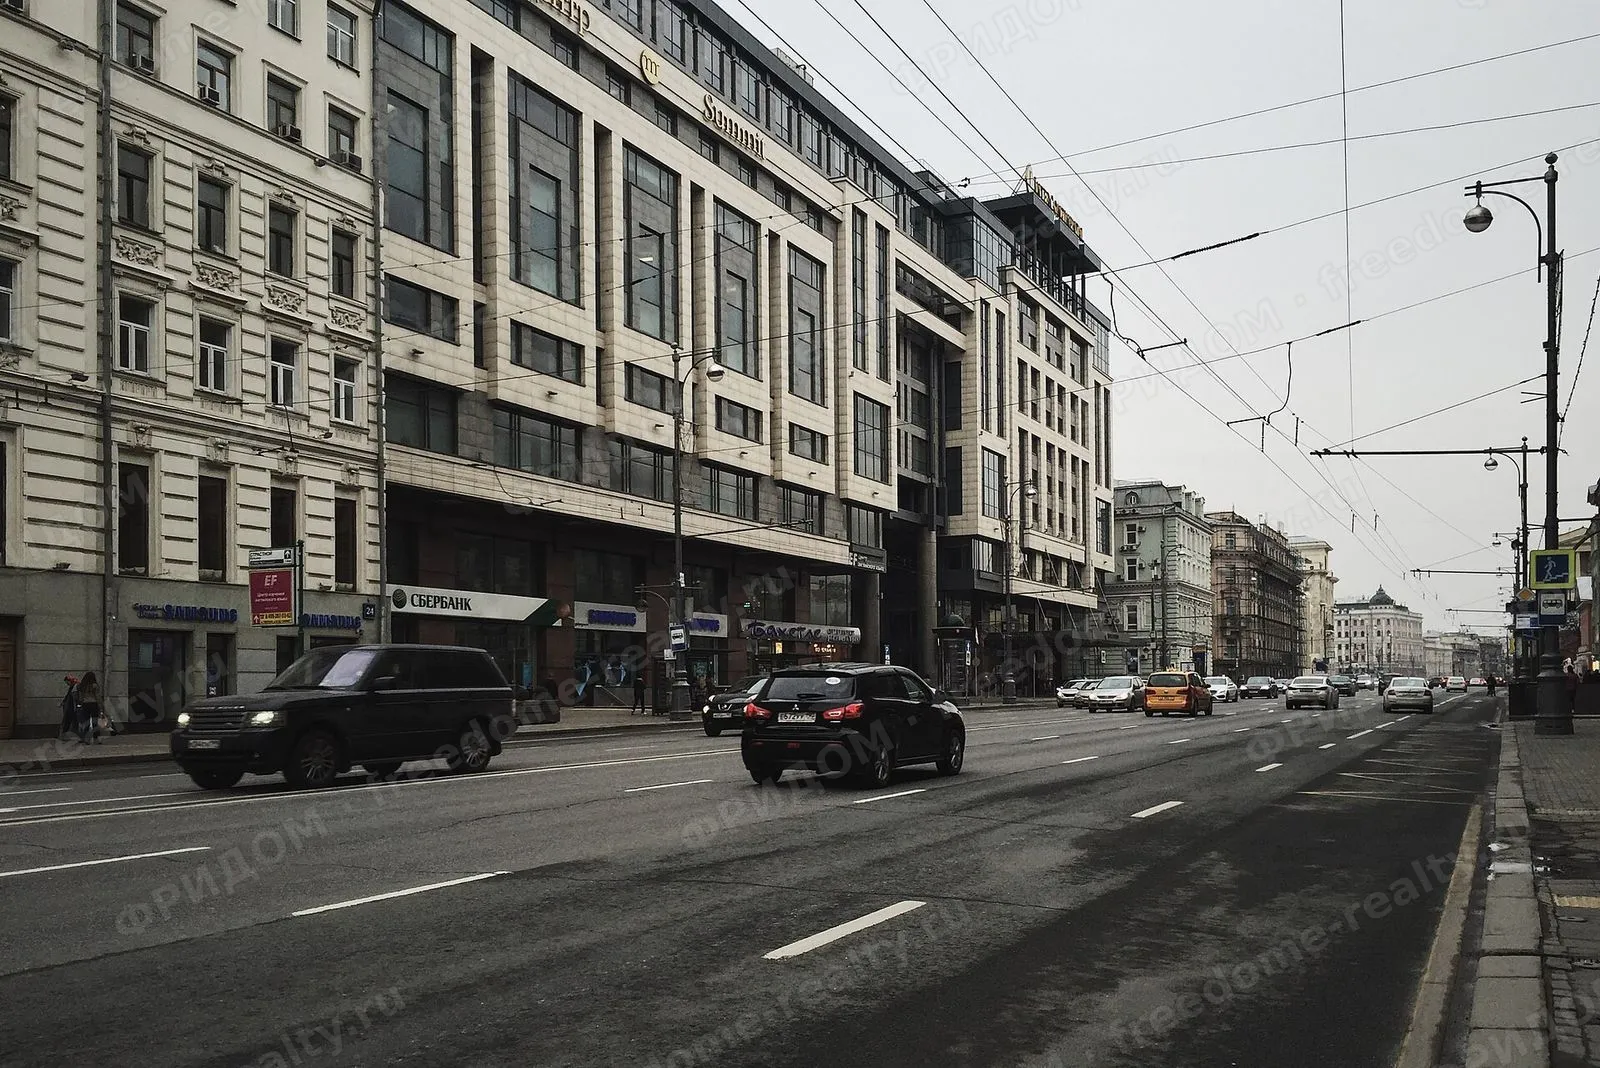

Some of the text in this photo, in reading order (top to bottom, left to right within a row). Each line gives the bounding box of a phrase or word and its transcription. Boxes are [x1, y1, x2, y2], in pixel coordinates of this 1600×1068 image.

[703, 94, 766, 160] Summit
[264, 574, 278, 586] EF
[366, 606, 374, 615] 24
[410, 593, 473, 611] СБЕРБАНК
[163, 604, 238, 623] SAMSUNG
[588, 610, 636, 626] SAMSUNG
